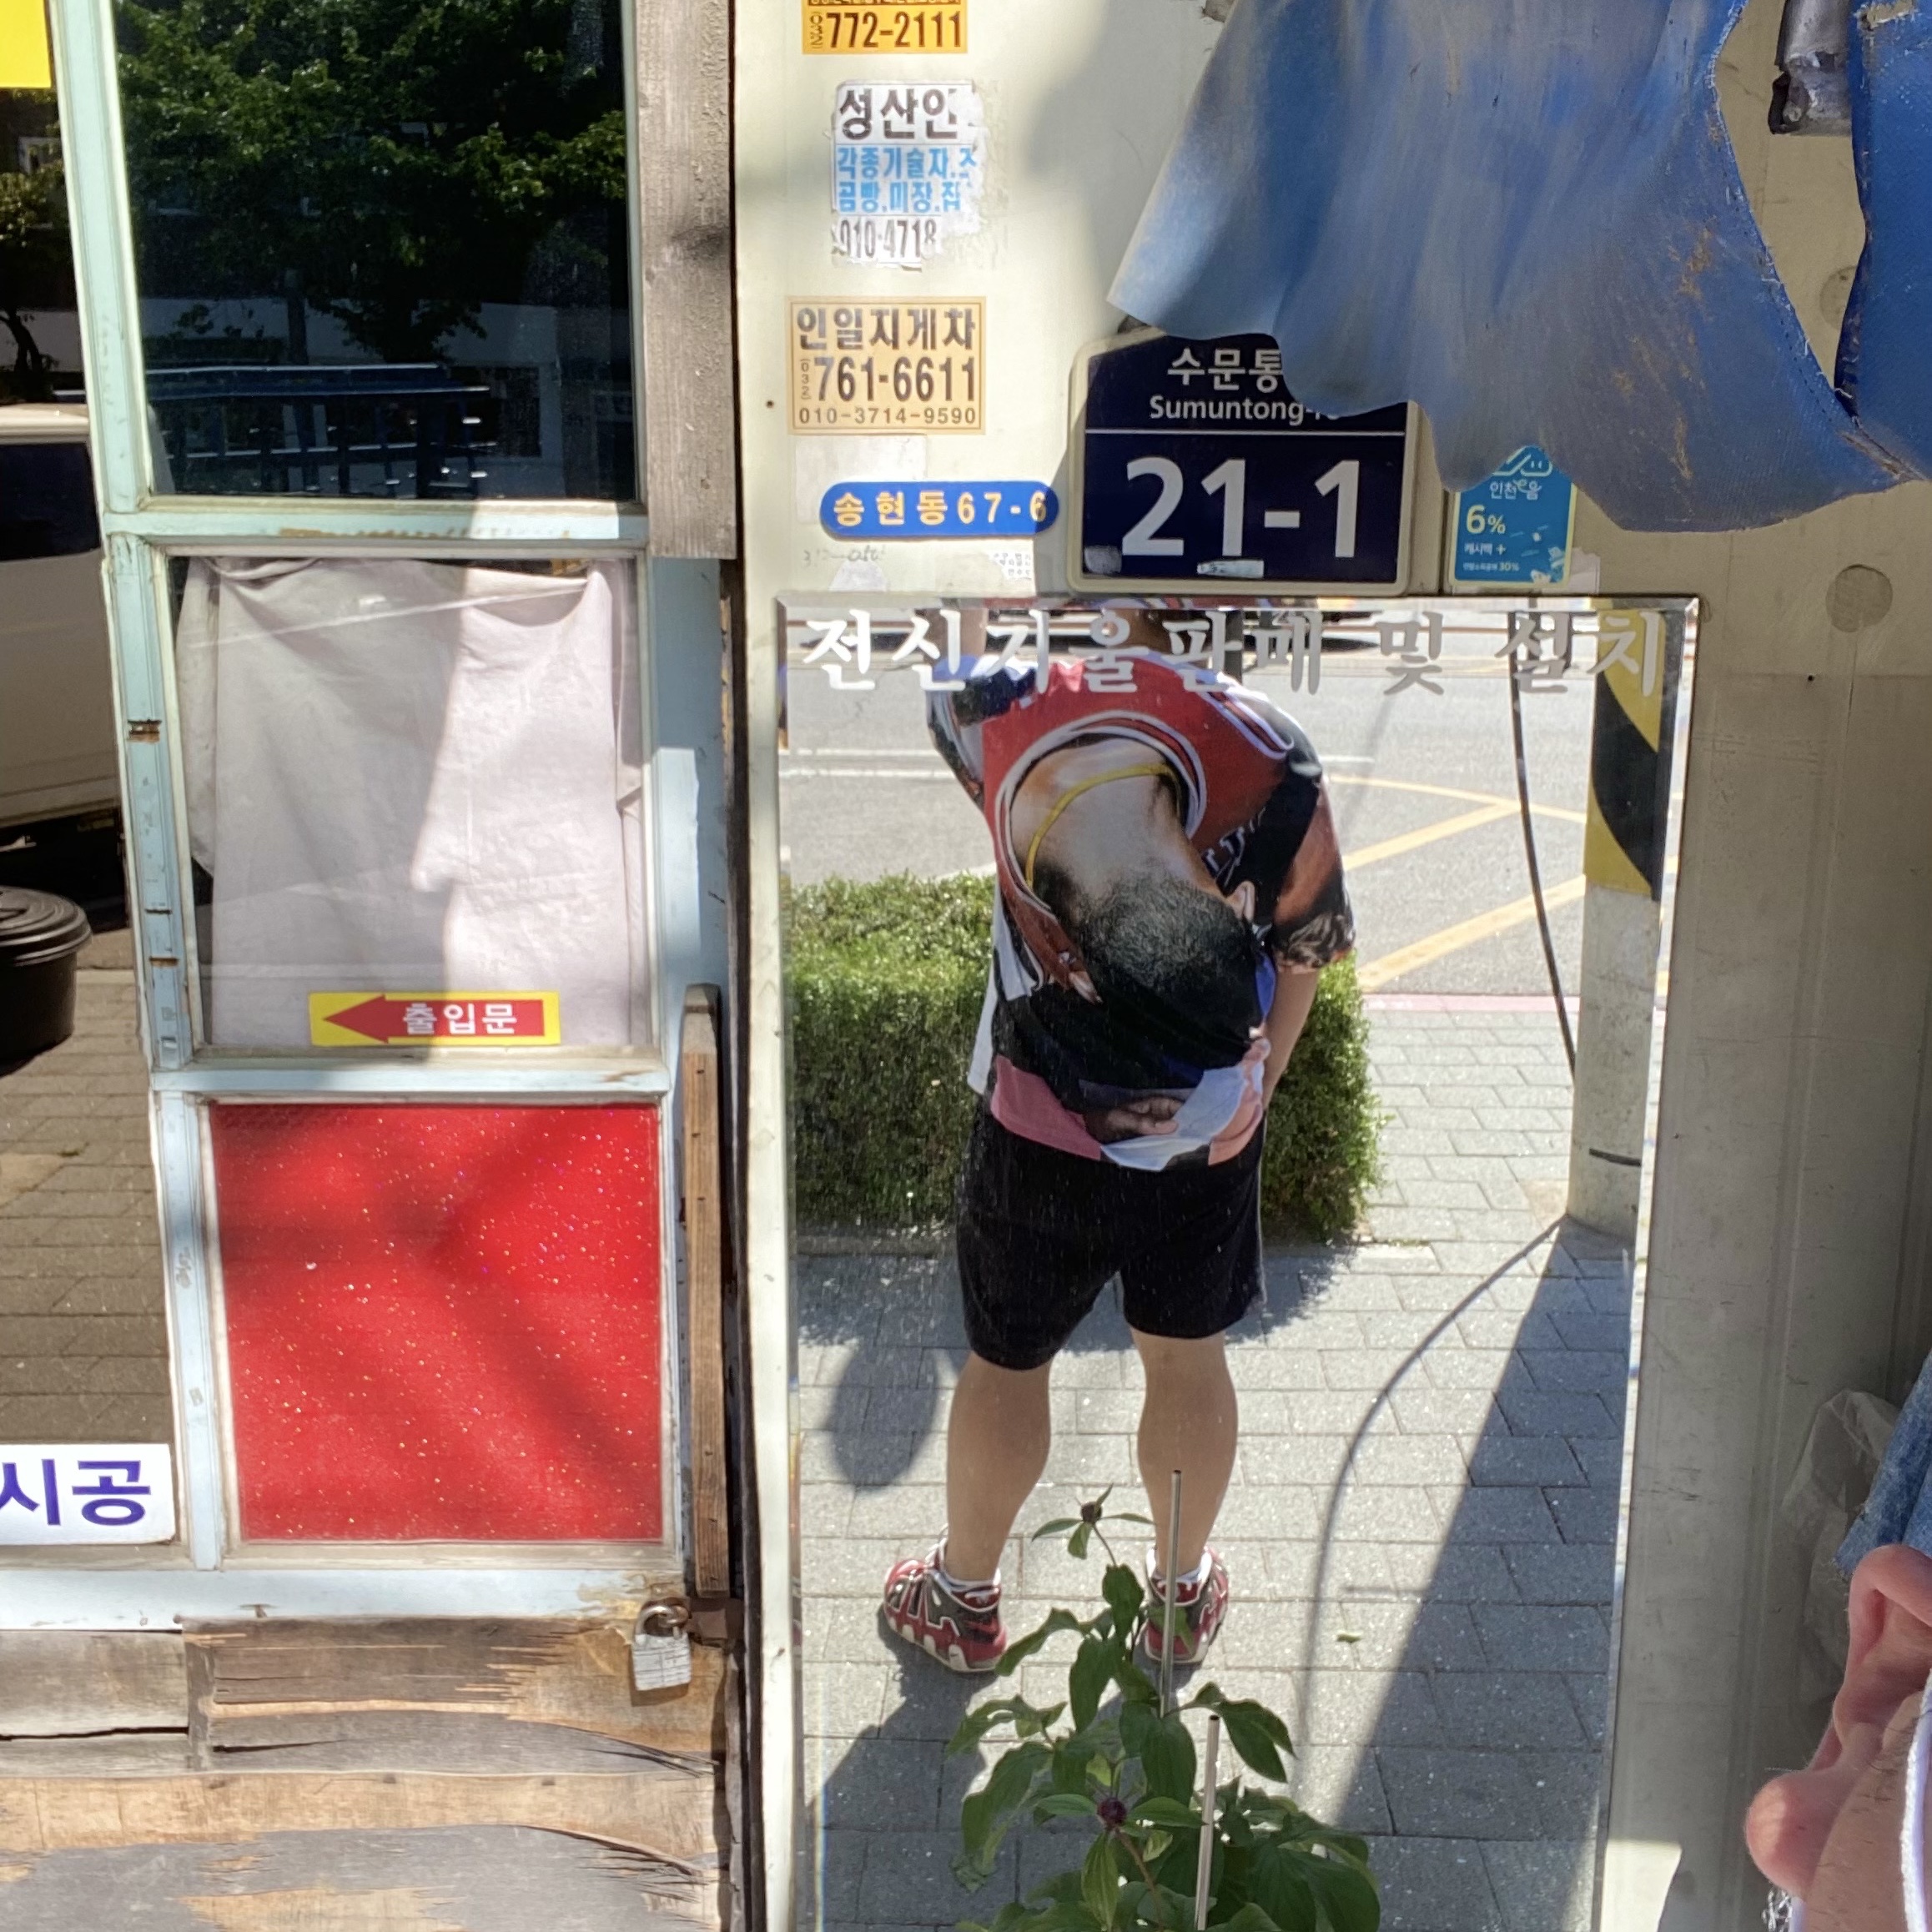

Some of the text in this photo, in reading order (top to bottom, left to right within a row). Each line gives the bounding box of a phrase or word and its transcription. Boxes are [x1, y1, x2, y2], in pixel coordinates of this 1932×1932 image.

[827, 11, 961, 48] 772-2111
[797, 308, 976, 350] 인일지게차
[814, 356, 975, 402] 761-6611
[799, 407, 976, 424] 010-3714-9590
[1122, 457, 1360, 557] 21-1
[1466, 504, 1506, 535] 6%
[1374, 611, 1445, 695] 및
[1494, 611, 1660, 697] 설치
[403, 1003, 517, 1034] 출입문
[0, 1458, 151, 1526] 시공
